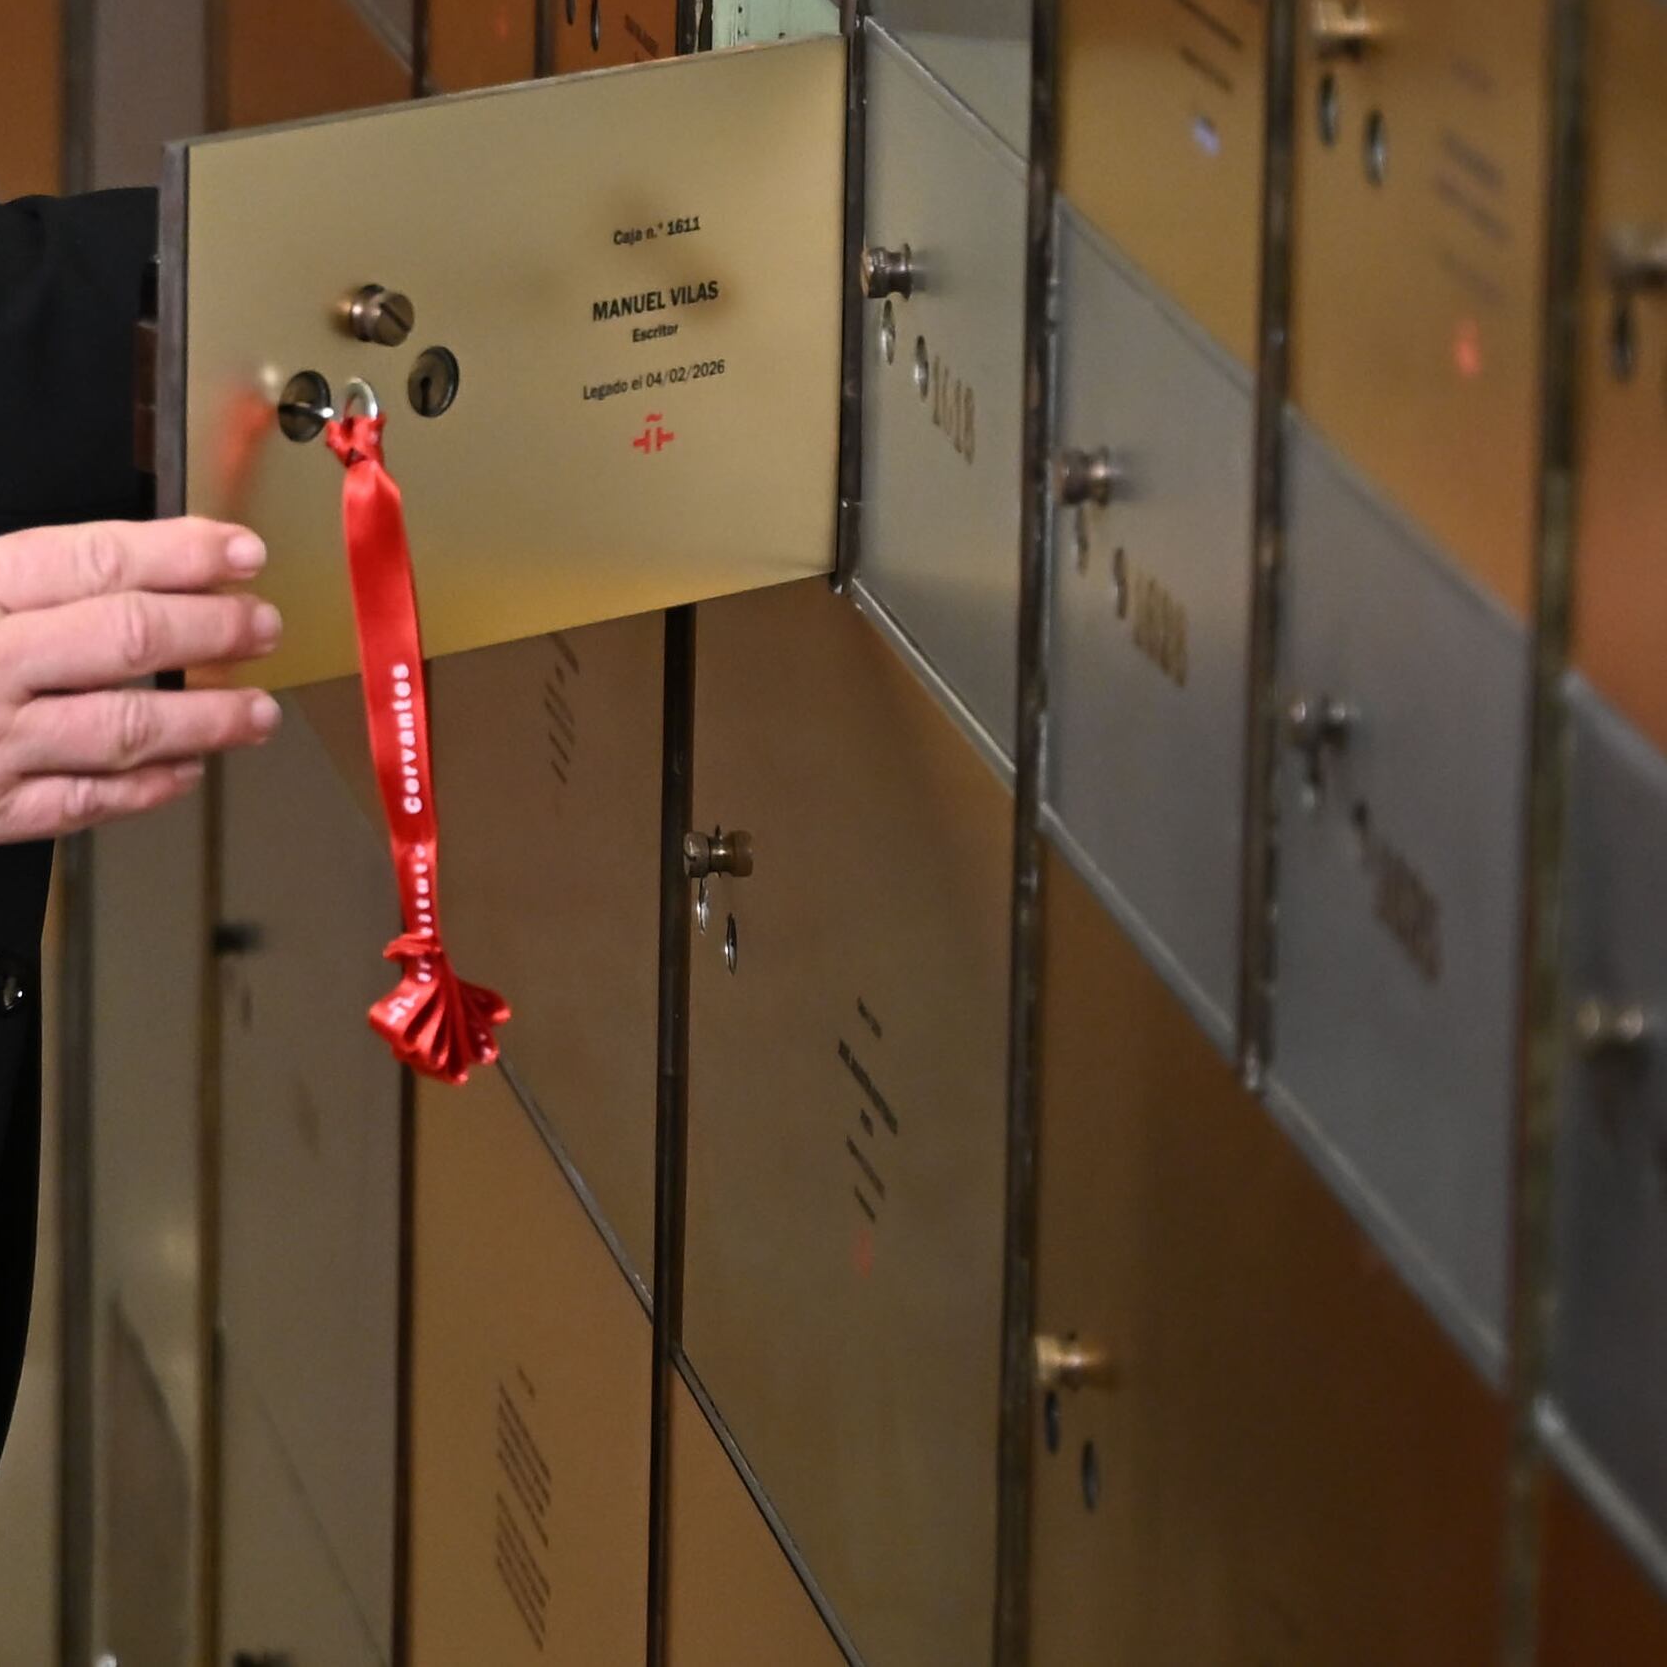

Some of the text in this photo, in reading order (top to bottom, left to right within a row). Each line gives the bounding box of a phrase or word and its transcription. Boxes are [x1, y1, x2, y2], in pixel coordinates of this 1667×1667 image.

[613, 228, 644, 246] Caja
[667, 216, 701, 236] 1611
[592, 280, 720, 322] MANUEL VILAS
[632, 322, 679, 343] Escritor
[583, 359, 726, 401] Legado el 04/02/2026
[391, 662, 423, 815] Cervantes
